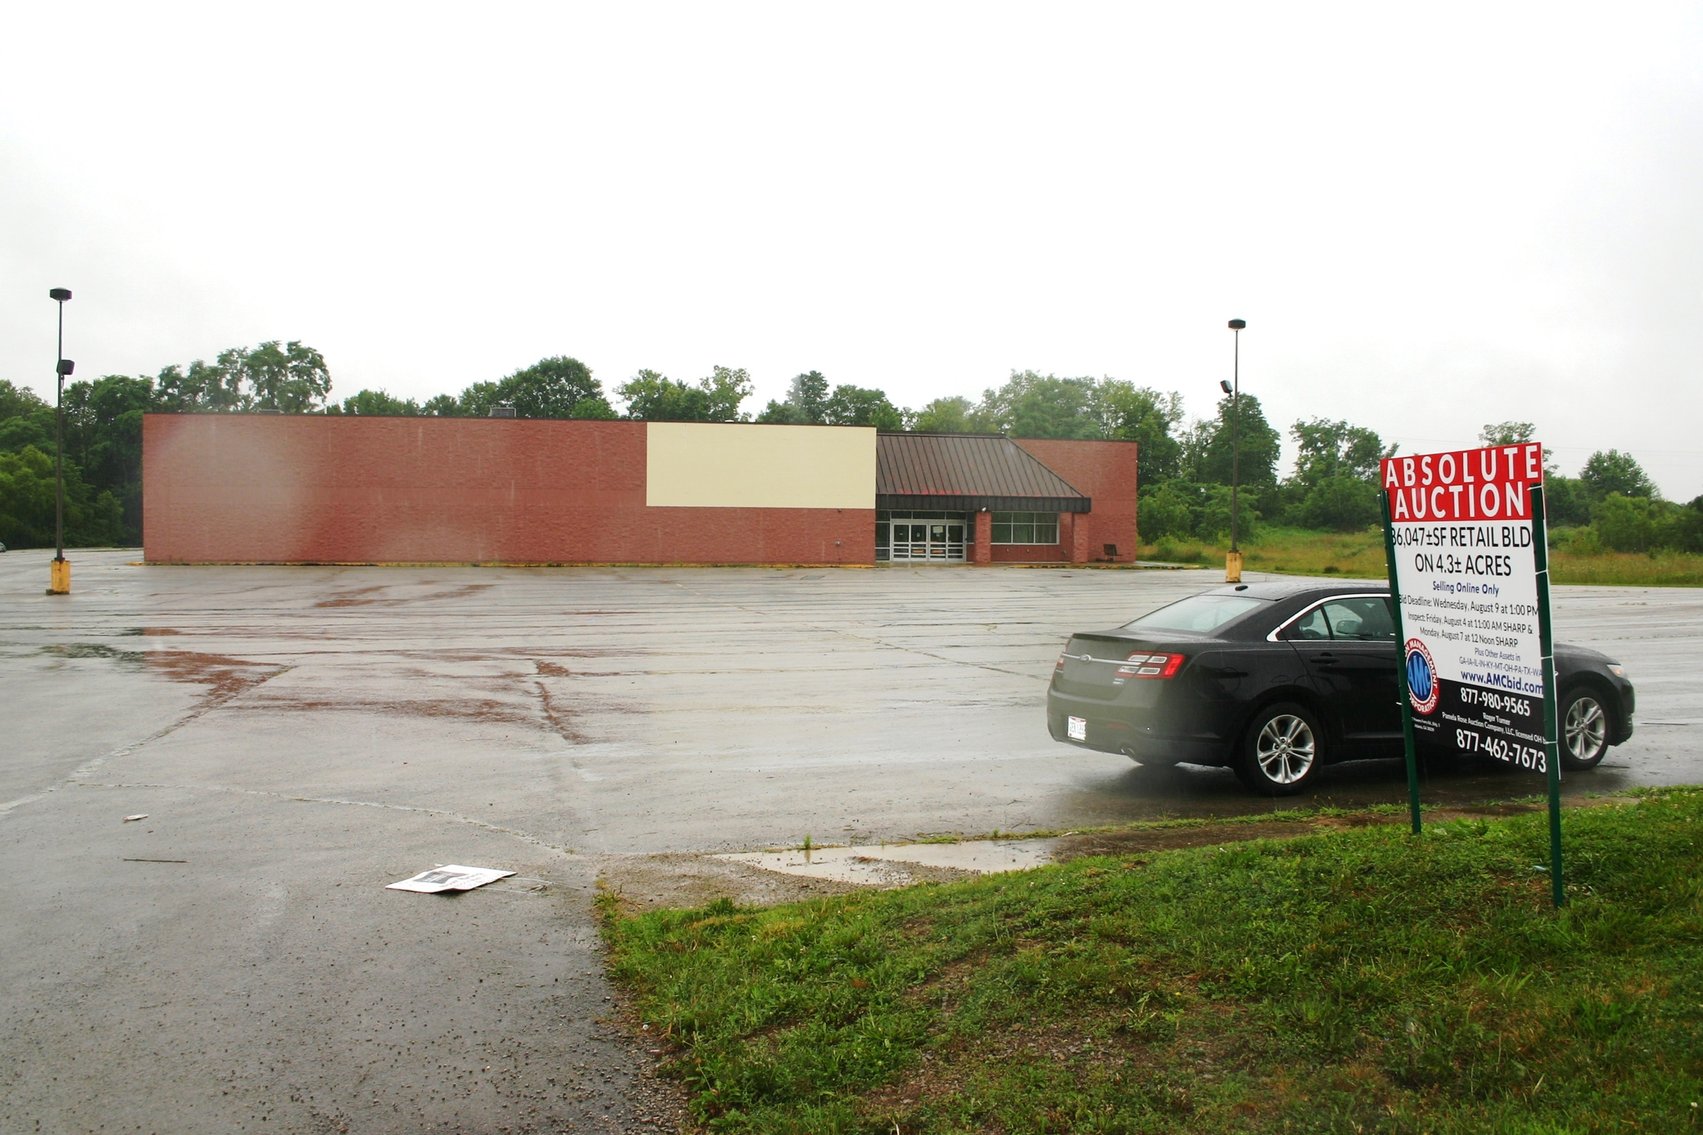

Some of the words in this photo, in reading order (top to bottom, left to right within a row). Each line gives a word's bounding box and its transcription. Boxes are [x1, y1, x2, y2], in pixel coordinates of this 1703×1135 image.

[1386, 445, 1539, 488] ABSOLUTE
[1395, 481, 1524, 519] AUCTION
[1450, 527, 1498, 547] RETAIL
[1502, 526, 1534, 547] BLD
[1415, 553, 1433, 572] ON
[1436, 554, 1462, 574] 4.3±
[1465, 555, 1511, 576] ACRES
[1433, 581, 1454, 594] Selling
[1456, 582, 1479, 594] Online
[1482, 584, 1499, 598] Only
[1407, 595, 1432, 607] Deadline:
[1433, 597, 1469, 612] Wednesday,
[1471, 601, 1494, 614] August
[1494, 603, 1500, 613] 9
[1500, 604, 1508, 614] at
[1510, 604, 1525, 615] 1:00
[1526, 605, 1539, 616] PM
[1408, 612, 1426, 622] Inspect:
[1444, 616, 1462, 627] August
[1463, 618, 1467, 626] 4
[1467, 619, 1473, 627] at
[1474, 619, 1490, 630] 11:00
[1491, 621, 1502, 631] AM
[1503, 622, 1526, 633] SHARP
[1527, 624, 1534, 634] &
[1420, 627, 1440, 638] Monday,
[1441, 630, 1460, 641] August
[1460, 632, 1464, 640] 7
[1464, 633, 1471, 642] at
[1471, 633, 1479, 643] 12
[1479, 634, 1495, 645] Noon
[1496, 636, 1519, 647] SHARP
[1474, 647, 1484, 657] Plus
[1484, 648, 1499, 659] Other
[1499, 651, 1515, 661] Assets
[1515, 653, 1521, 662] in
[1407, 655, 1431, 697] AMC
[1461, 671, 1544, 694] www.AMCbid.com
[1460, 687, 1530, 717] 877-980-9565
[1457, 714, 1468, 724] Rose
[1468, 717, 1484, 728] Auction
[1533, 734, 1542, 743] OH
[1456, 728, 1547, 773] 877-462-7673
